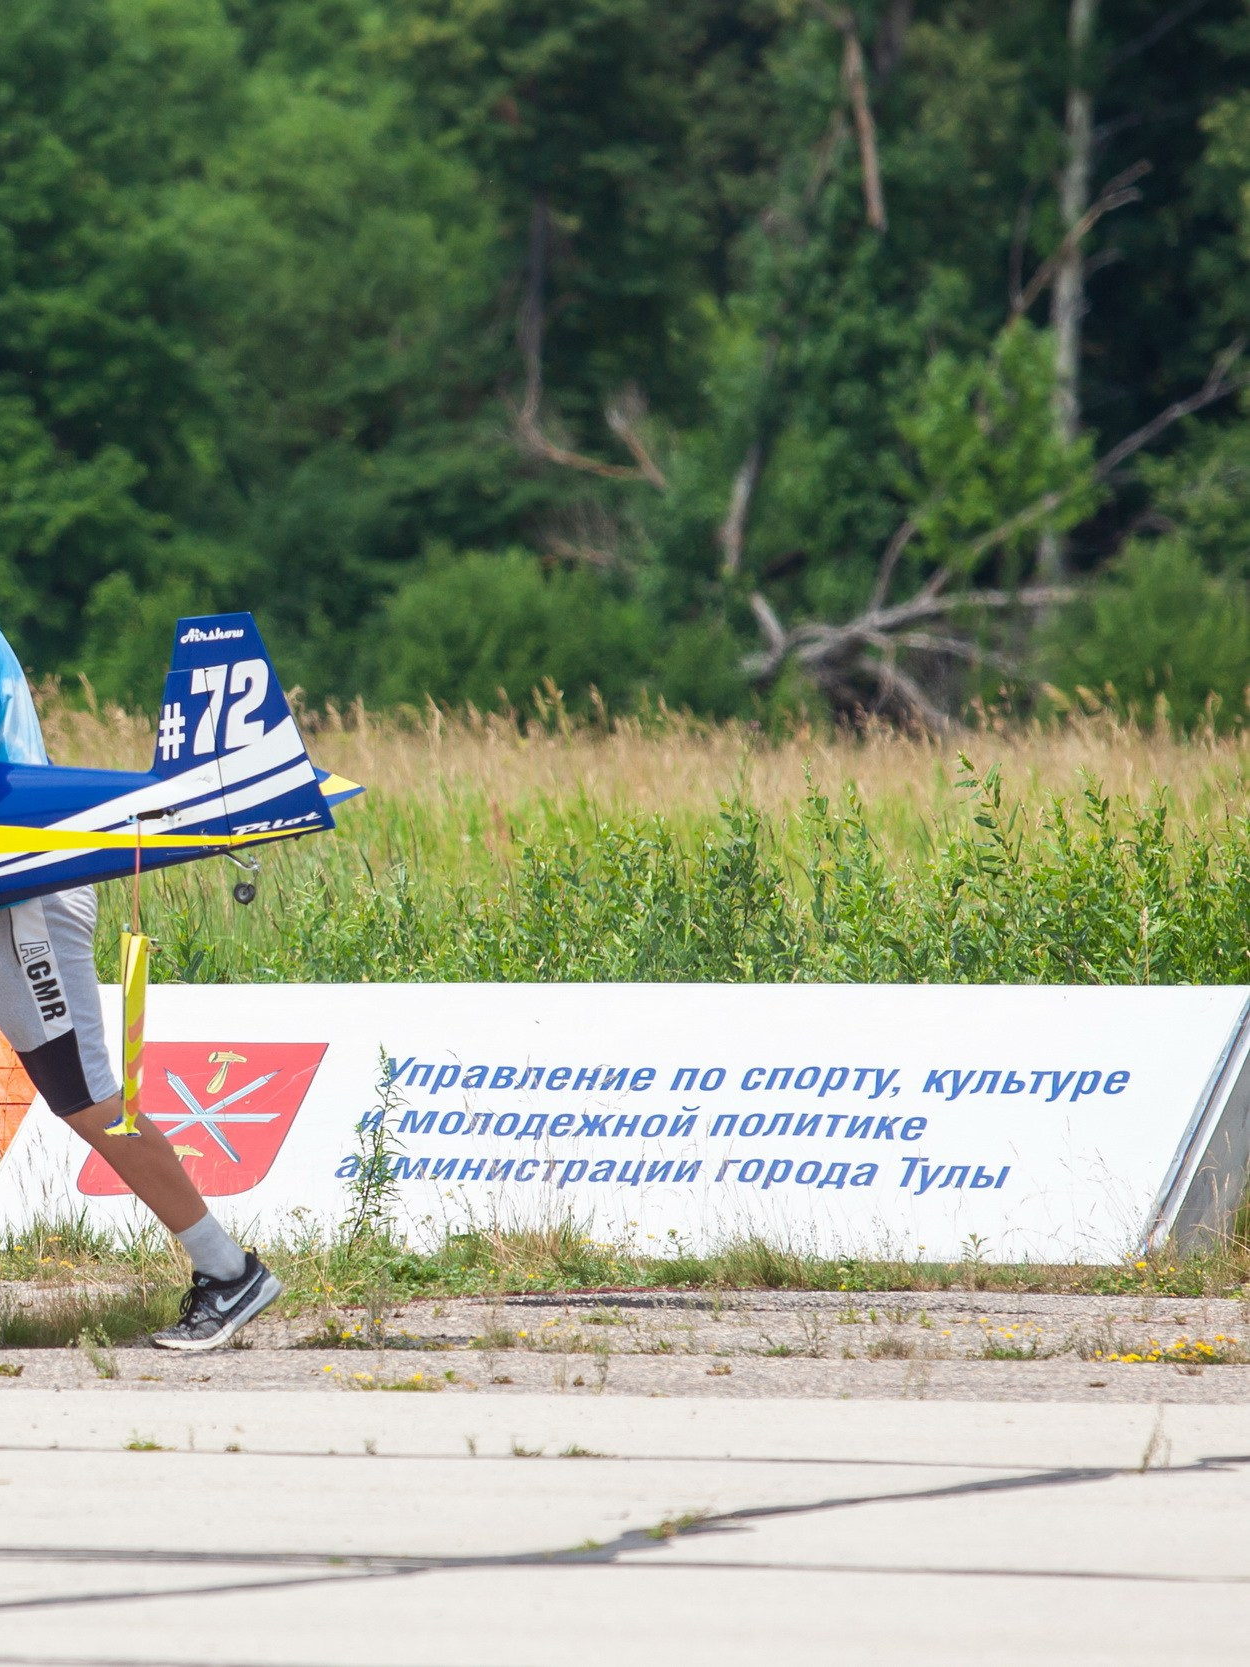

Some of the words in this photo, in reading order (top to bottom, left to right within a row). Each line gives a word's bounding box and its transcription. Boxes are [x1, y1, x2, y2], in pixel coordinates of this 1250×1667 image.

[180, 627, 245, 644] Airshow
[158, 658, 269, 762] #72
[231, 811, 322, 835] Pilot
[382, 1056, 656, 1096] Управление
[669, 1066, 726, 1092] по
[740, 1066, 901, 1100] спорту,
[922, 1069, 1130, 1103] культуре
[396, 1106, 699, 1141] молодежной
[709, 1113, 928, 1141] политике
[714, 1158, 879, 1190] города
[898, 1157, 1011, 1196] Тулы
